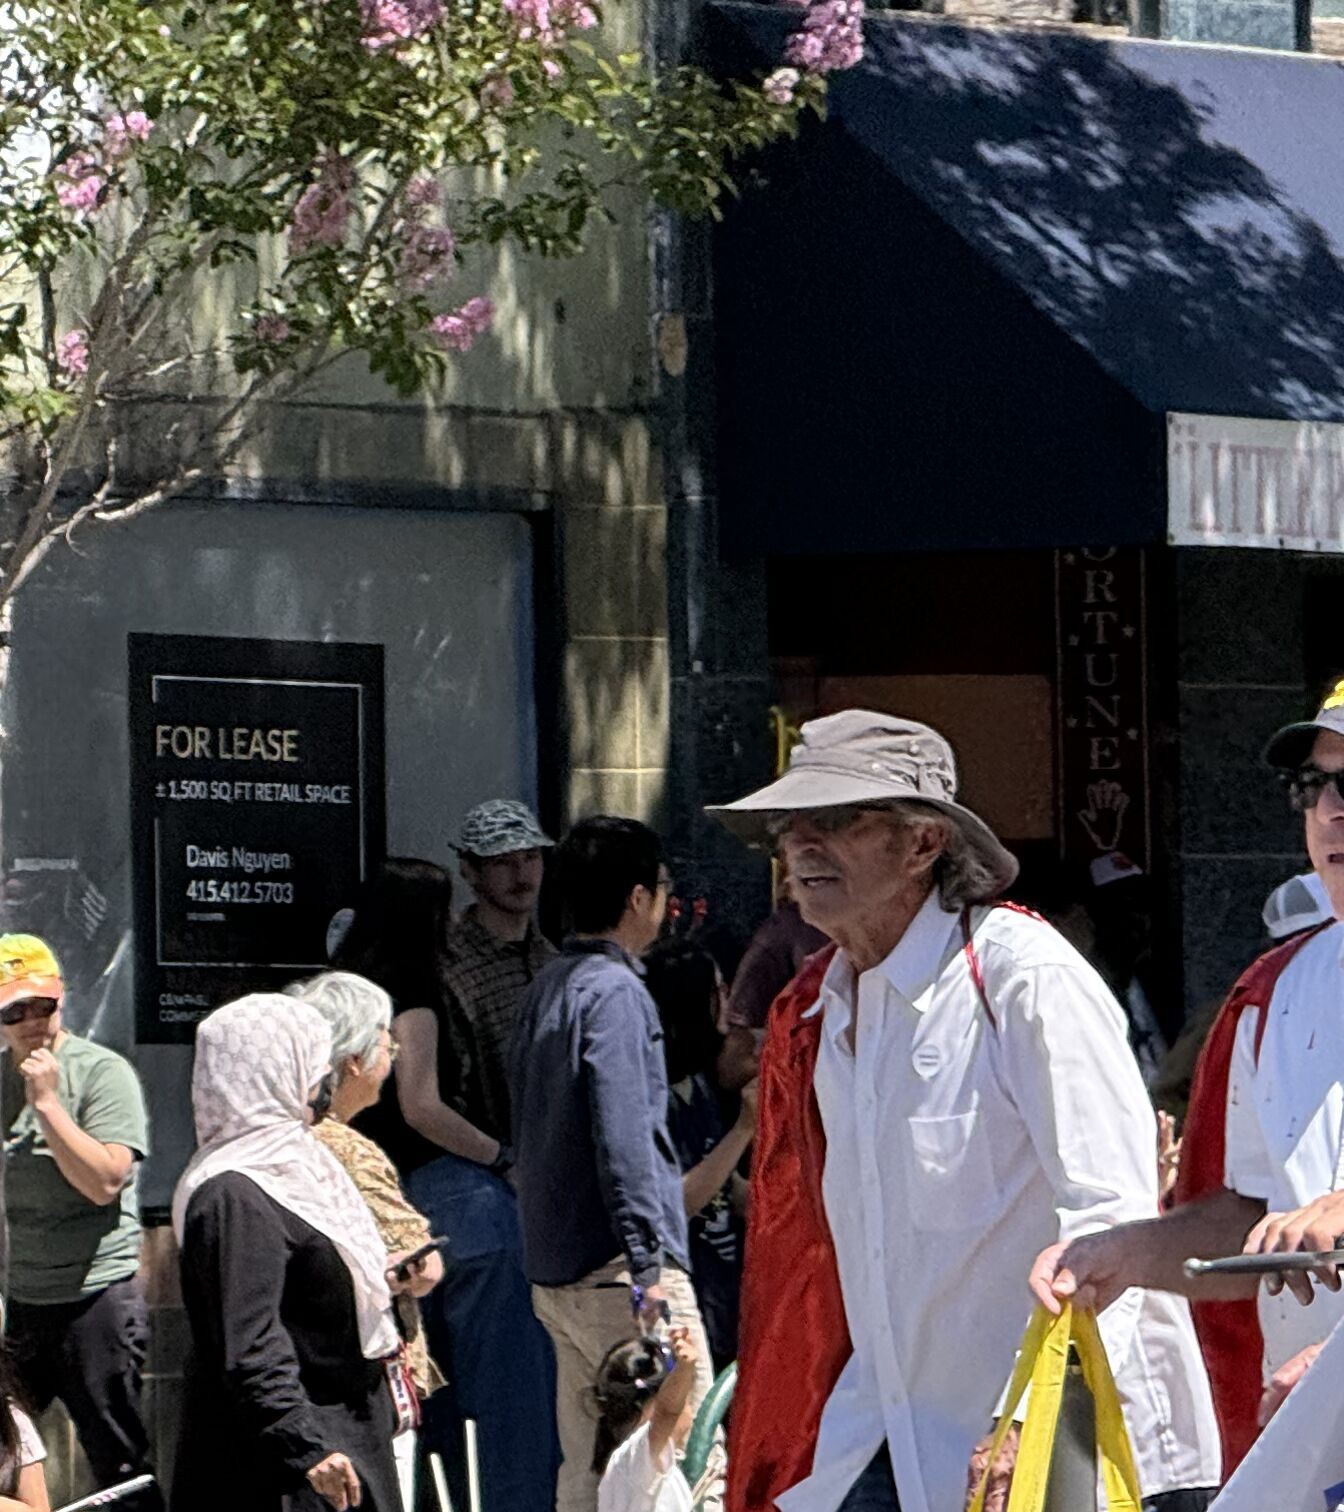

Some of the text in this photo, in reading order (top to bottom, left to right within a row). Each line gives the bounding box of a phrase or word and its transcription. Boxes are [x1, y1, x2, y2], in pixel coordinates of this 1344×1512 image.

[156, 724, 300, 763] FOR LEASE
[255, 782, 301, 803] RETAIL
[305, 785, 352, 804] SPACE
[186, 844, 291, 873] Davis Nguyen
[186, 879, 294, 904] 415.412.5703
